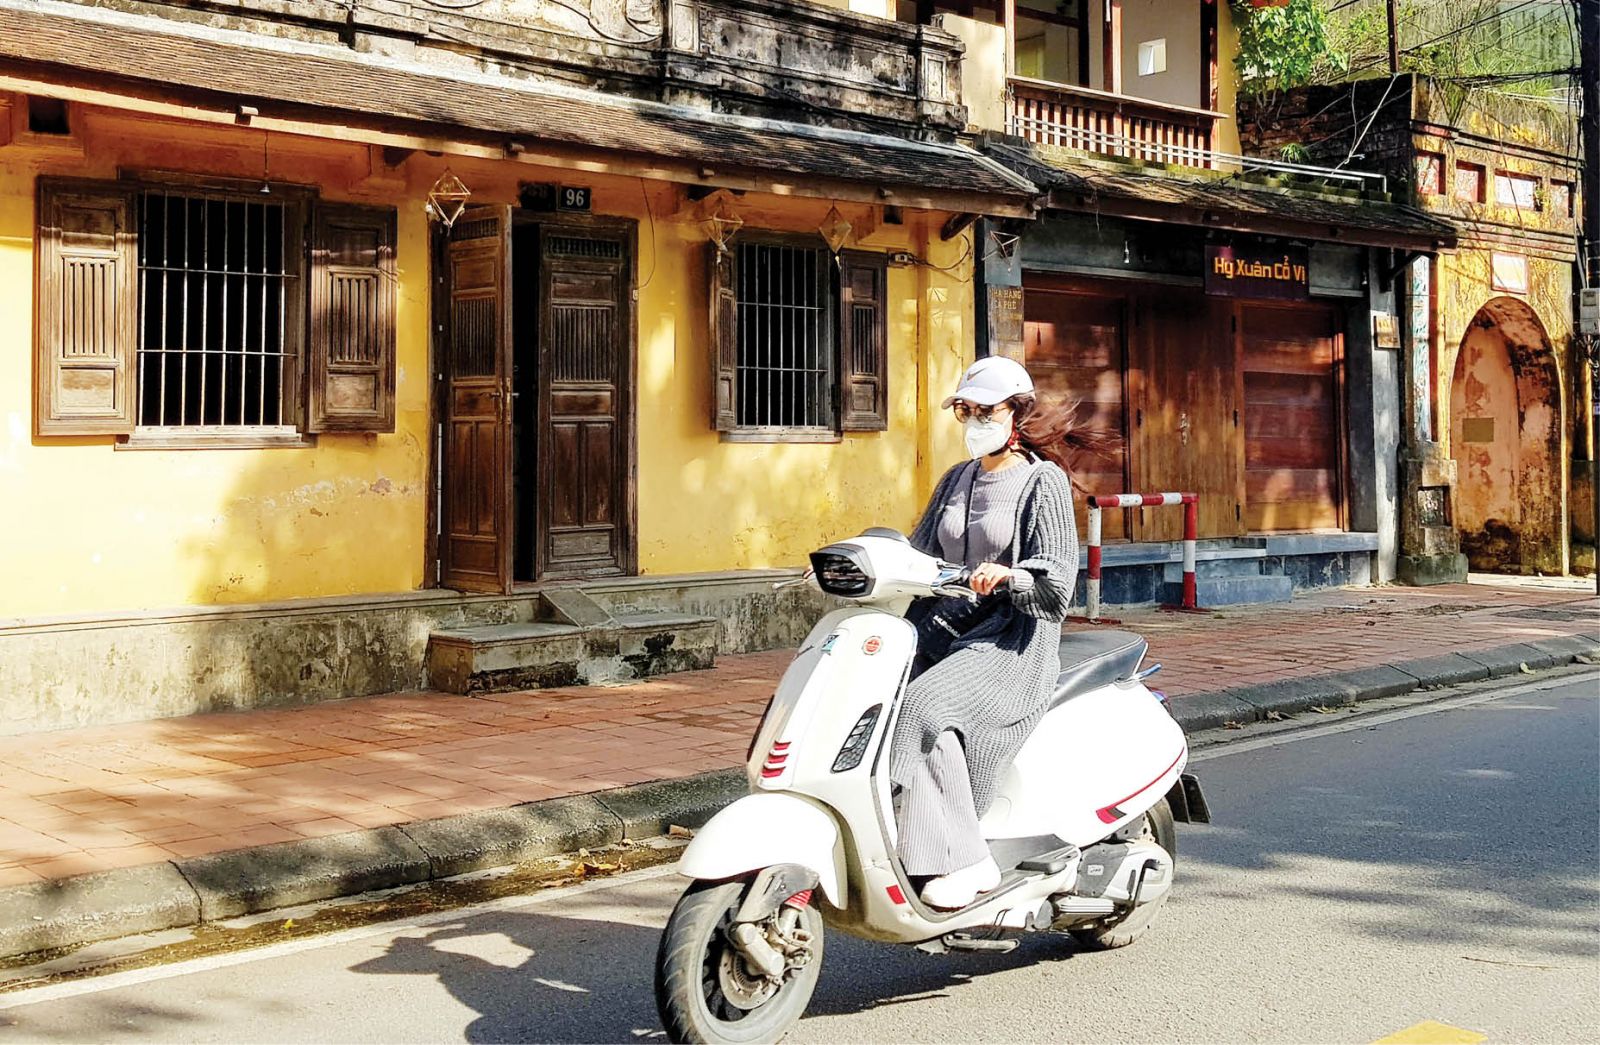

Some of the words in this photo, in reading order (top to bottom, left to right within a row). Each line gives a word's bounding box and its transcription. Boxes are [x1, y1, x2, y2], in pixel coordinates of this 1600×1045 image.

[566, 189, 584, 207] 96
[1236, 259, 1272, 278] Xuân
[1274, 255, 1290, 280] Cổ
[1293, 264, 1306, 285] Vị
